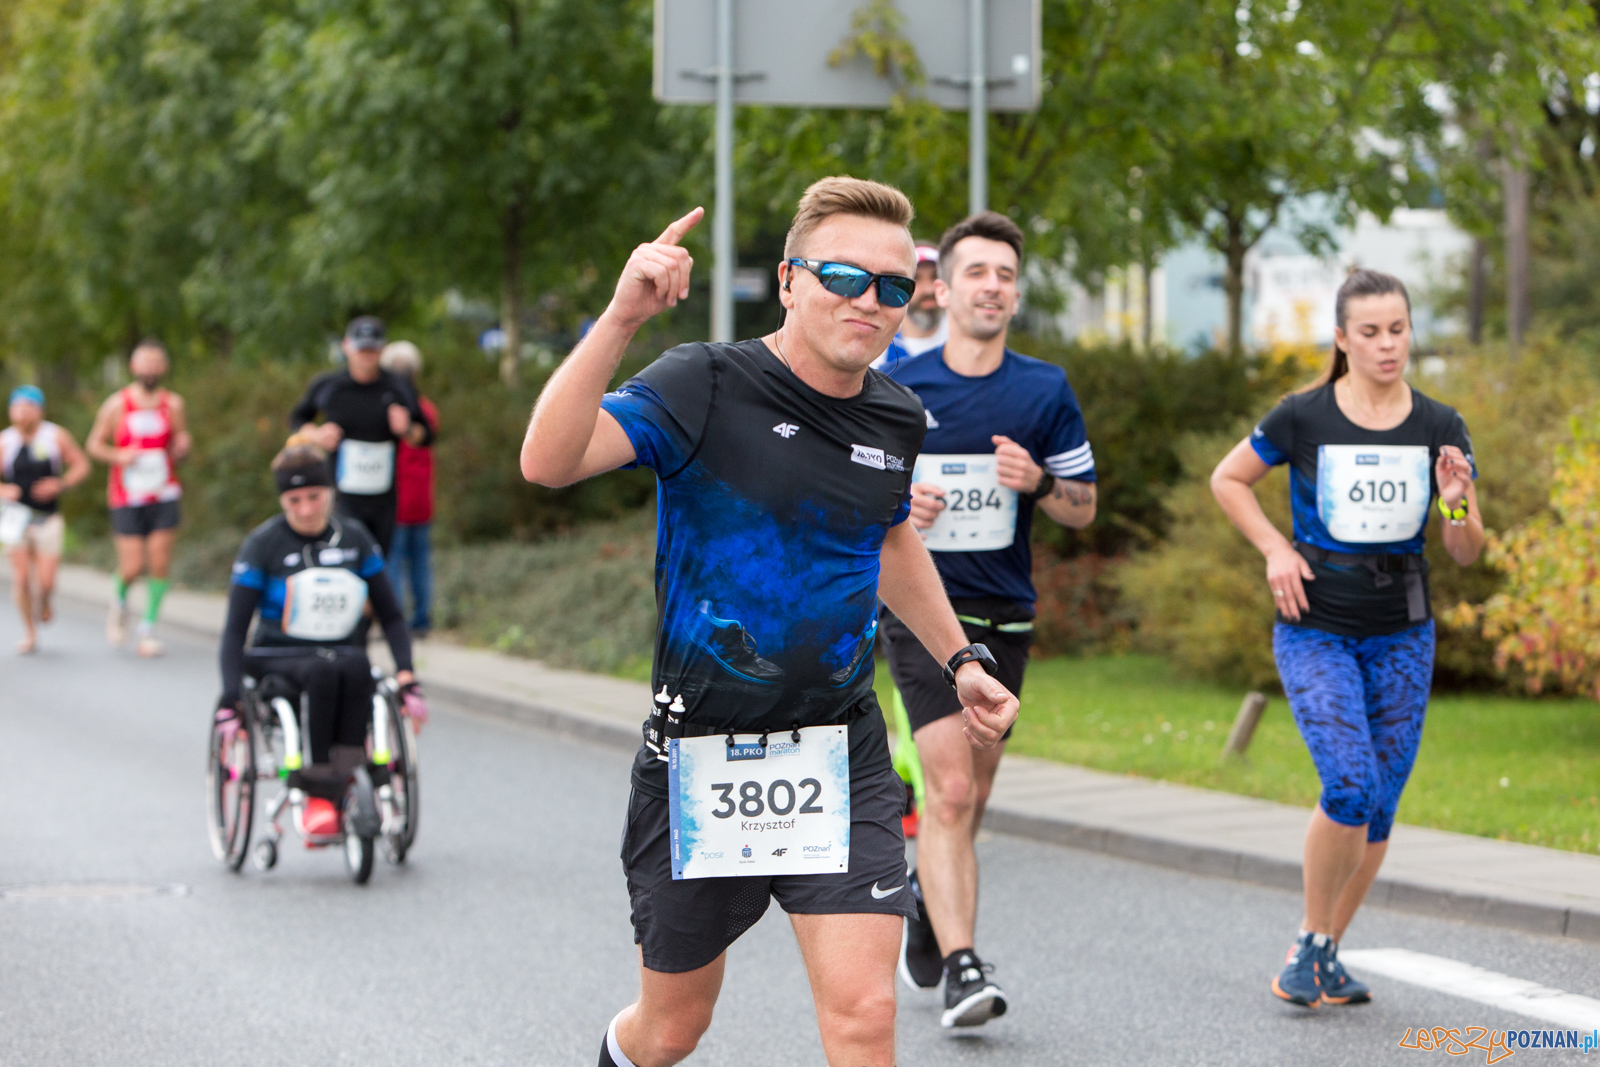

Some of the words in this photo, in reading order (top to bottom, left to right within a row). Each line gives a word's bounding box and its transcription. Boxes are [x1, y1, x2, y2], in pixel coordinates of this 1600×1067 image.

[773, 422, 800, 438] 4F
[1349, 480, 1407, 503] 6101
[711, 778, 823, 819] 3802
[741, 819, 796, 833] Krzysztof
